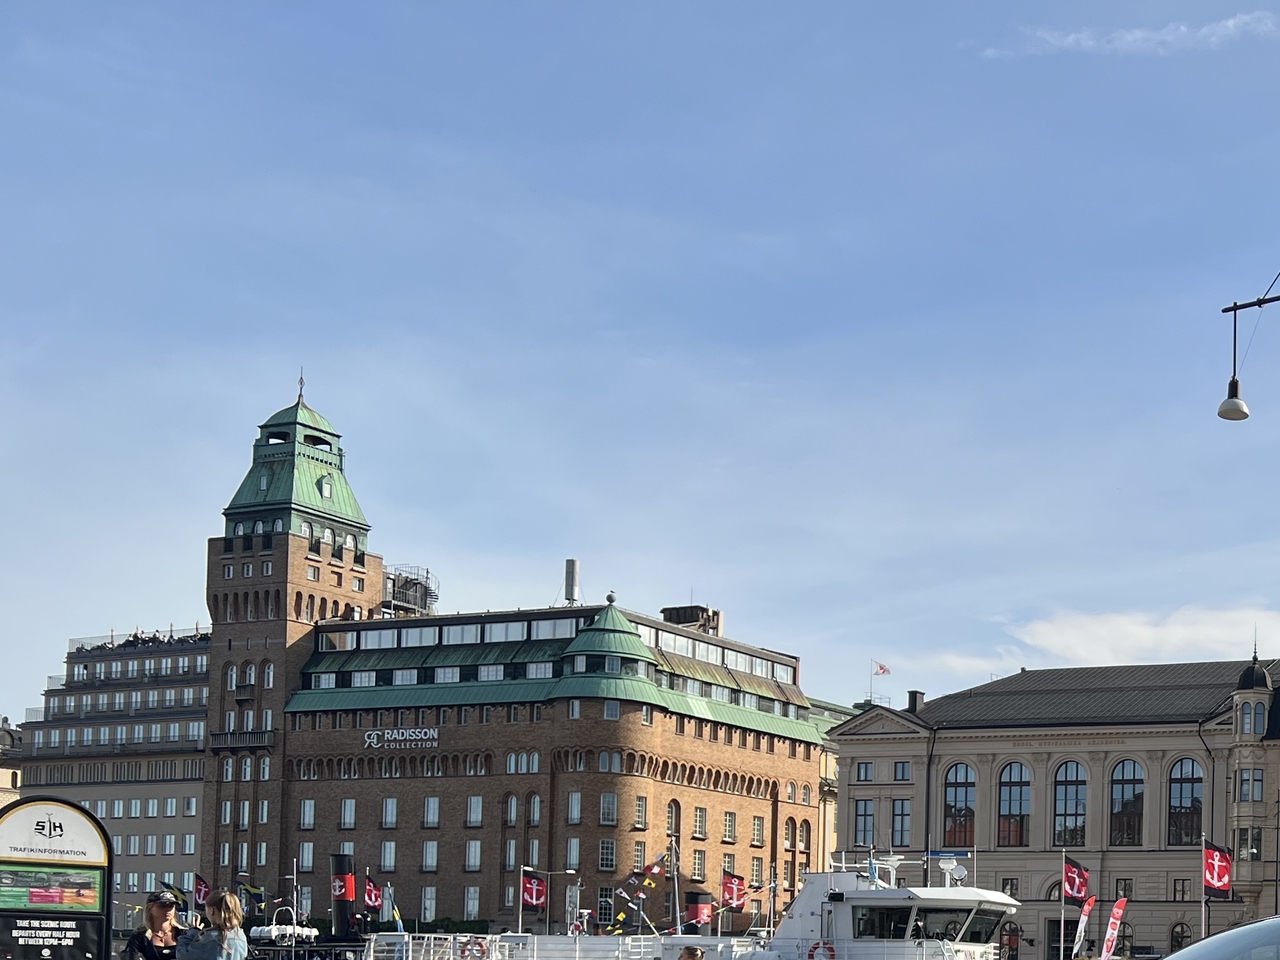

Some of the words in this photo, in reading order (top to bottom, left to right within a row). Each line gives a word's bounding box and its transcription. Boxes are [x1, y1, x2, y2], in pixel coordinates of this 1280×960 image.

[384, 728, 438, 741] RADISSON
[384, 741, 438, 749] COLLECTION
[9, 846, 87, 857] TRAFIKINFORMATION
[16, 920, 30, 928] TAKE
[30, 920, 40, 928] THE
[40, 920, 60, 928] SCENIC
[60, 921, 76, 929] ROUTE
[12, 929, 36, 938] DEPARTS
[36, 930, 52, 938] EVERY
[52, 930, 66, 938] HALF
[66, 931, 80, 939] HOUR
[18, 937, 44, 945] BETWEEN
